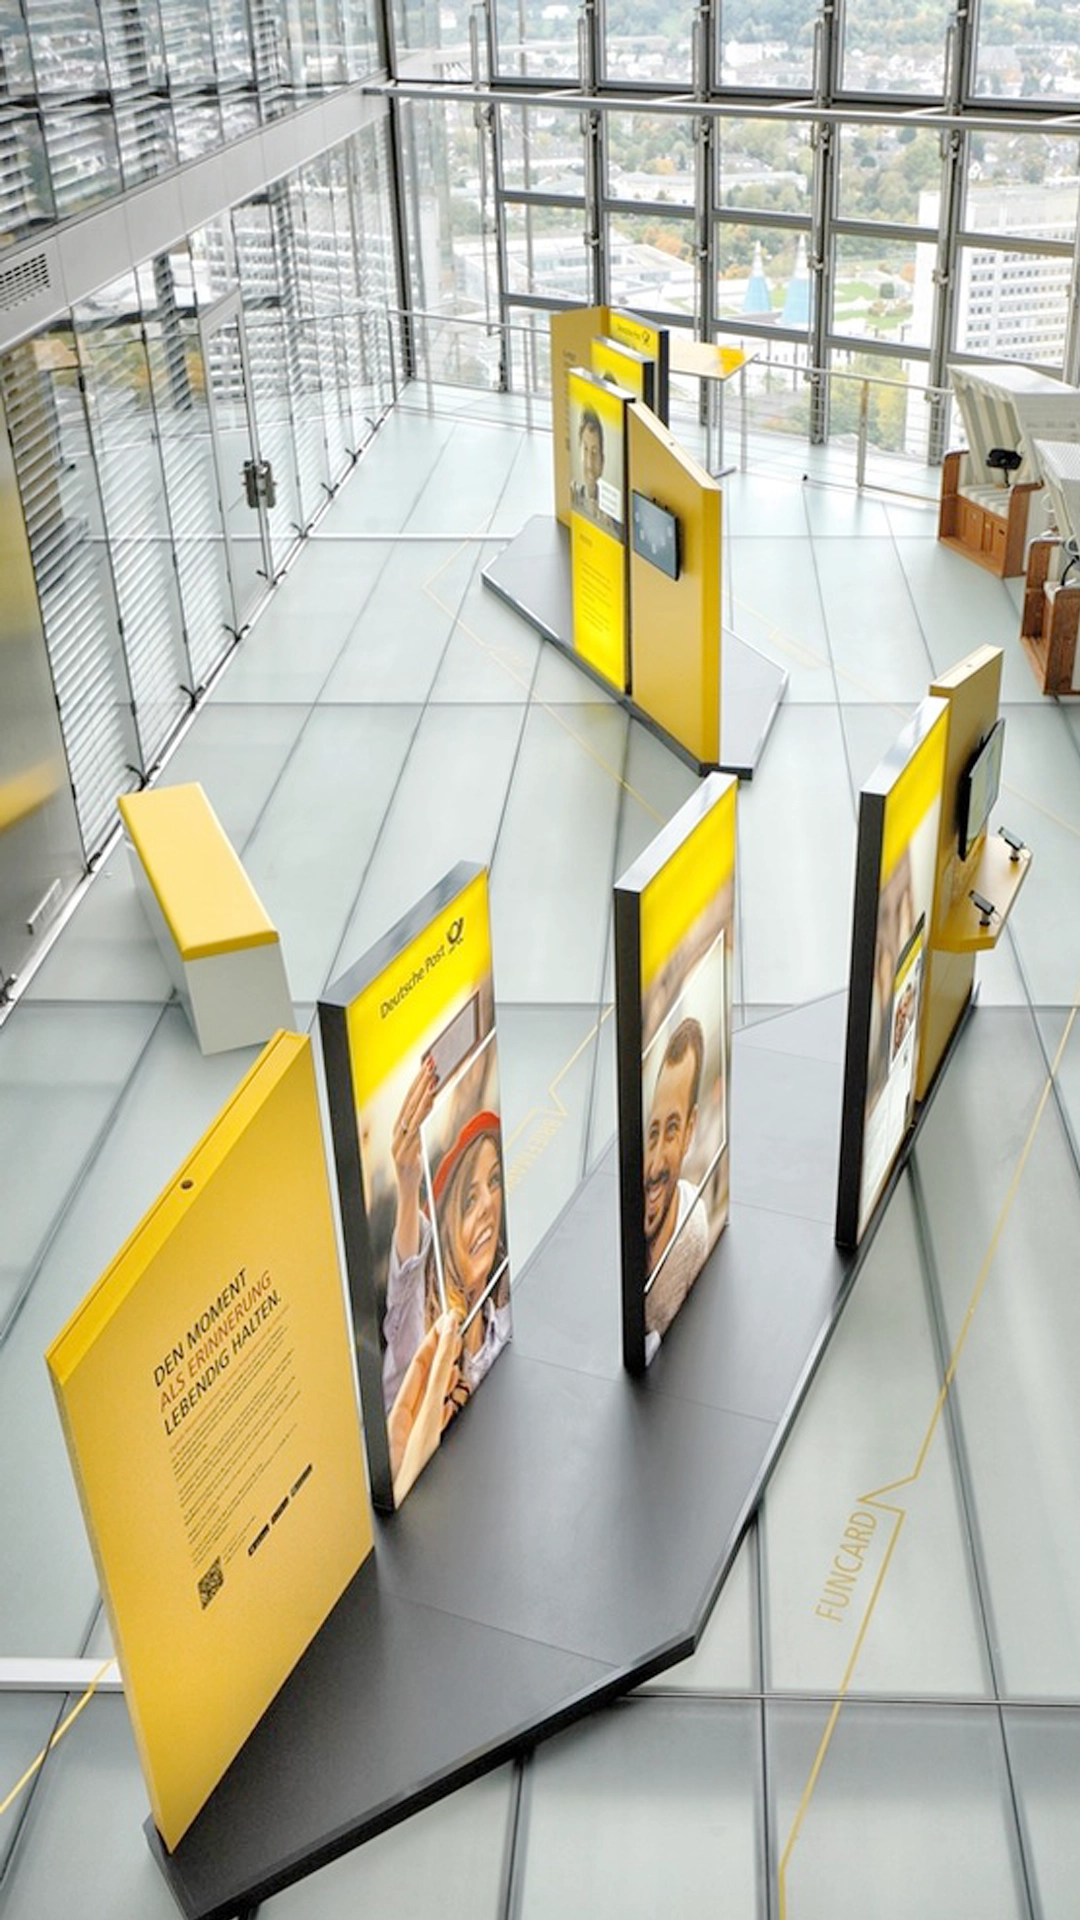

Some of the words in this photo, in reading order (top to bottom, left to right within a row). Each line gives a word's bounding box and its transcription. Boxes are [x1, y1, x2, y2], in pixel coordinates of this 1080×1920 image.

[380, 967, 424, 1019] Deutsche
[425, 944, 445, 974] Post
[153, 1341, 184, 1387] DEN
[187, 1268, 246, 1349] MOMENT
[160, 1371, 185, 1413] ALS
[187, 1269, 271, 1378] ERINNERUNG
[164, 1348, 230, 1436] LEBENDIG
[231, 1289, 282, 1354] HALTEN.
[814, 1511, 878, 1623] FUNCARD
